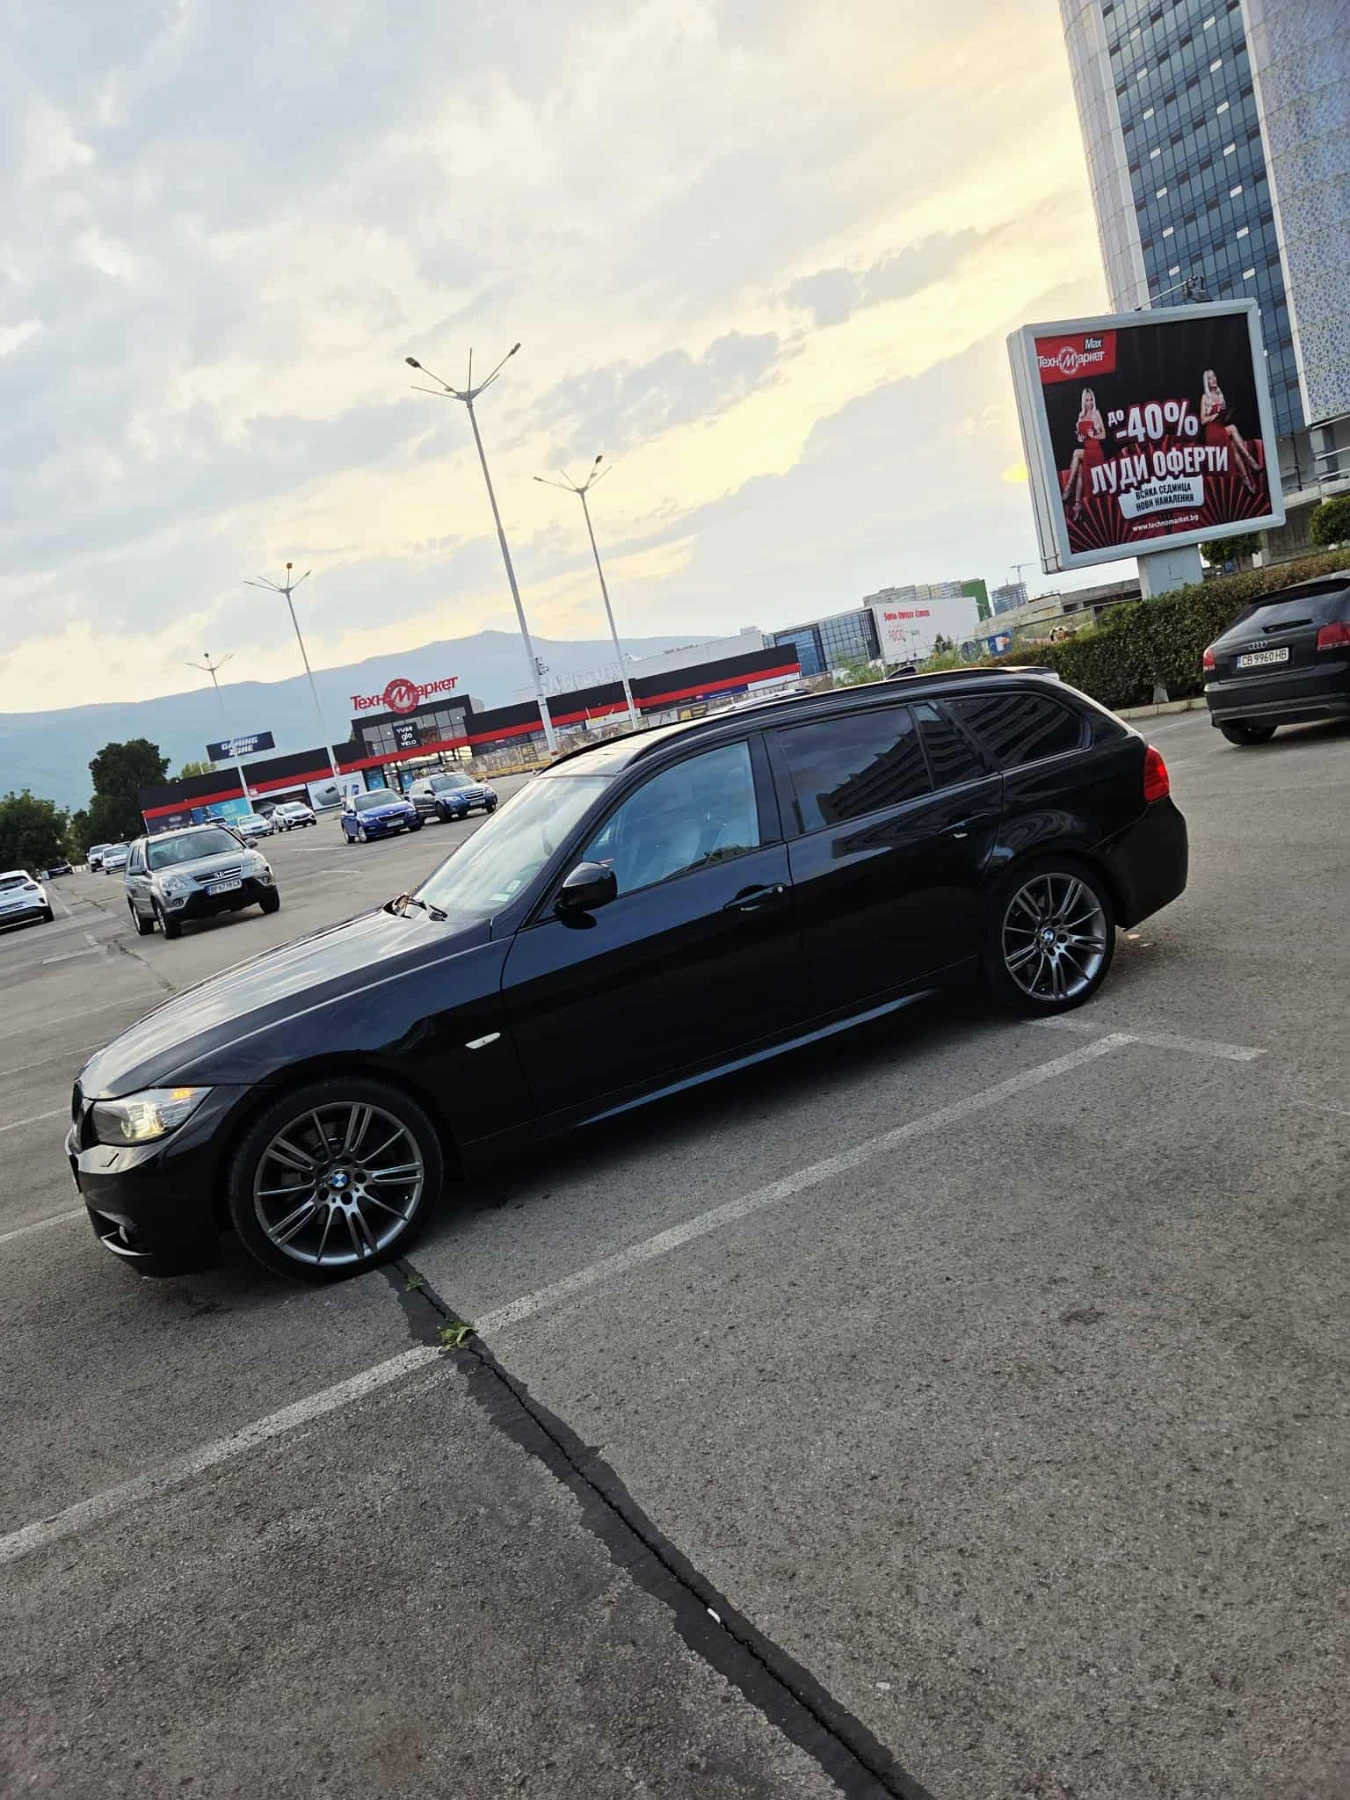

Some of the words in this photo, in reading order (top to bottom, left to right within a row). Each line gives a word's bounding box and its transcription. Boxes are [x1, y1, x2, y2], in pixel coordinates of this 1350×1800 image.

[1116, 401, 1198, 442] -40%
[1091, 454, 1148, 494] ЛУДИ
[1153, 446, 1228, 475] ОФЕРТИ
[1159, 482, 1191, 494] СЕДМИЦА
[1132, 514, 1199, 532] www.technomarket.bg
[1254, 651, 1274, 664] 9960
